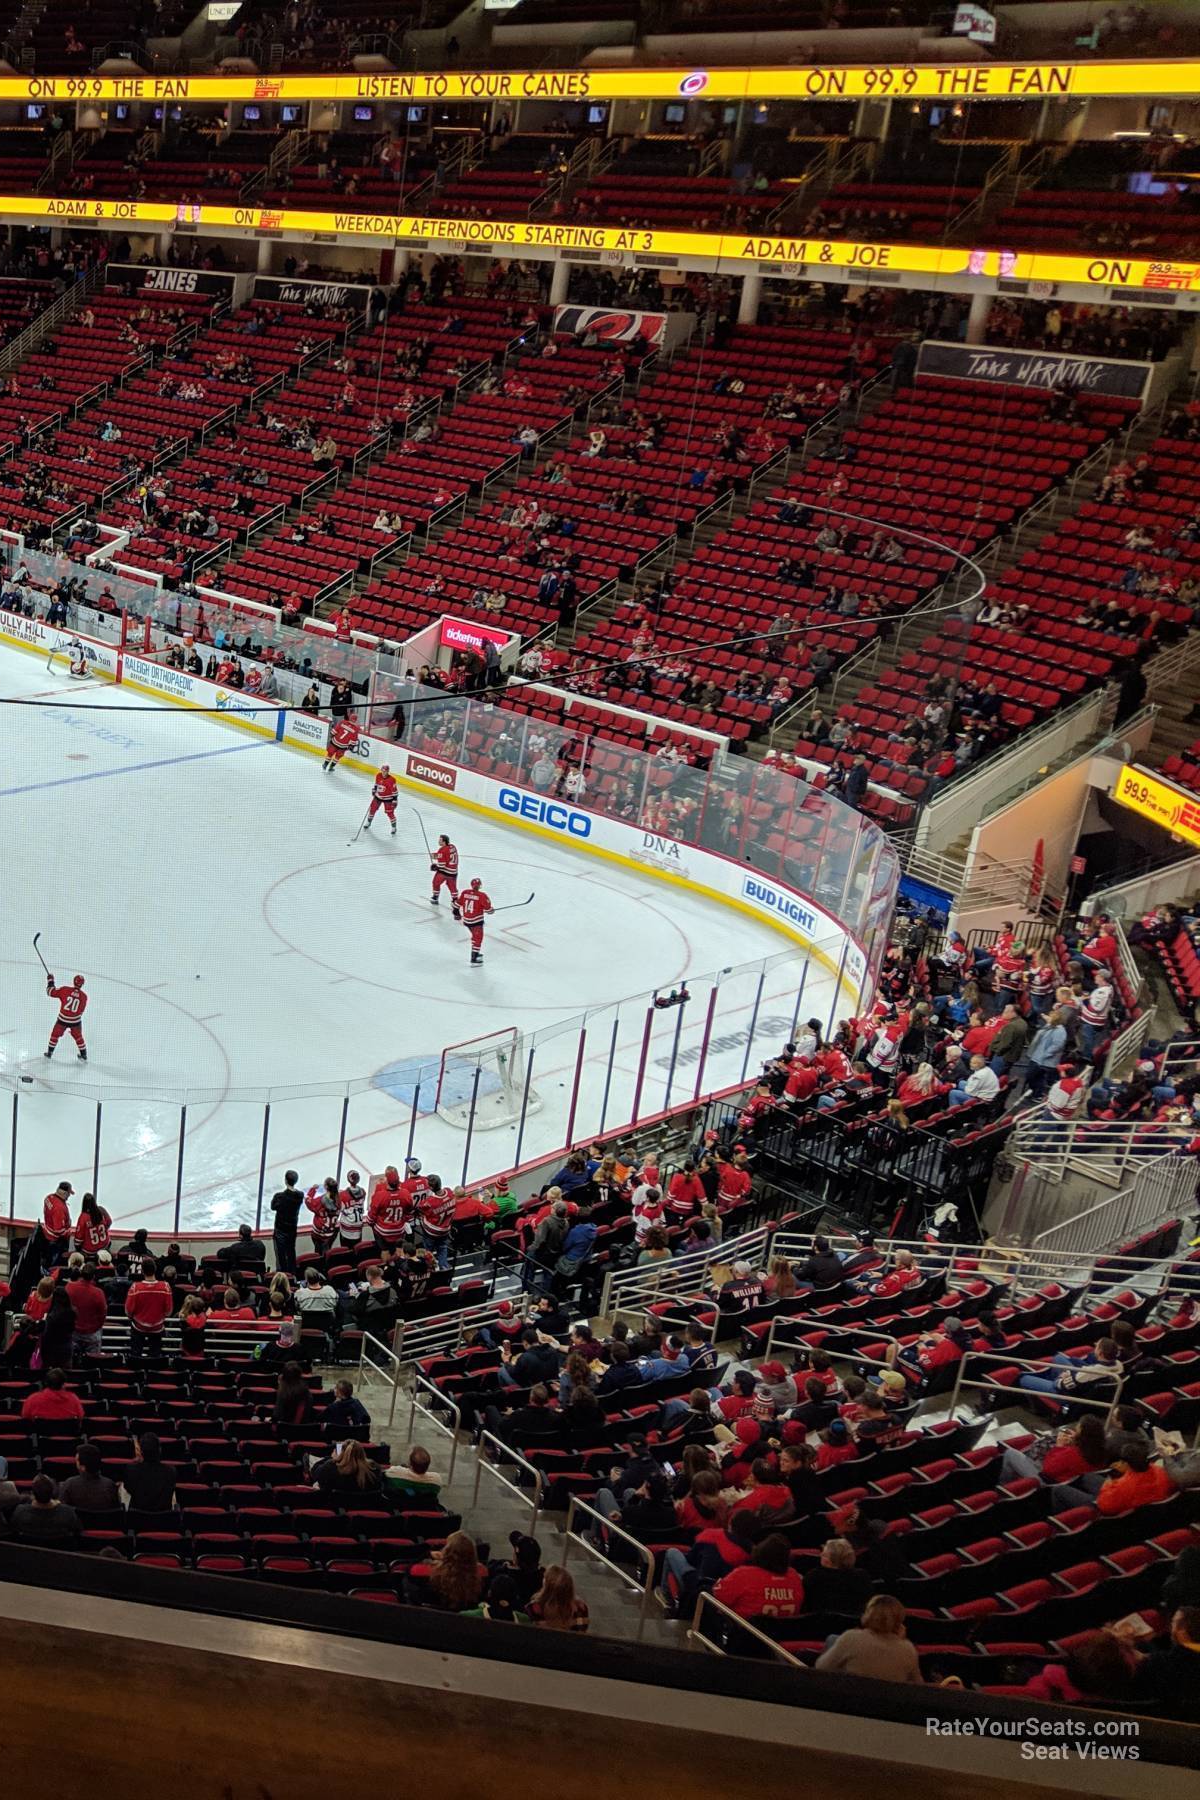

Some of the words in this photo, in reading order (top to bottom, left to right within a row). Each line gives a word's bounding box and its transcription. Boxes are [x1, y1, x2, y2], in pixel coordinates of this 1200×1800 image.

[29, 78, 56, 97] ON
[67, 78, 102, 97] 99.9
[113, 79, 144, 97] THE
[155, 79, 189, 97] FAN
[357, 76, 414, 97] LISTEN
[425, 74, 448, 97] TO
[460, 74, 511, 97] YOUR
[522, 73, 590, 96] CANES
[806, 69, 846, 95] ON
[864, 69, 918, 94] 99.9
[936, 69, 990, 93] THE
[1008, 67, 1071, 93] FAN
[46, 200, 87, 216] ADAM
[94, 203, 104, 216] &
[112, 203, 137, 218] JOE
[234, 209, 254, 224] ON
[335, 215, 402, 233] WEEKDAY
[410, 222, 516, 242] AFTERNOONS
[524, 226, 605, 247] STARTING
[615, 231, 639, 248] AT
[642, 233, 653, 250] 3
[608, 252, 620, 261] 104
[742, 239, 807, 261] ADAM
[819, 243, 833, 263] &
[846, 246, 890, 266] JOE
[784, 263, 798, 273] 105
[1087, 260, 1131, 283] ON
[1148, 264, 1171, 274] 99.9
[144, 270, 198, 293] CANES
[1143, 273, 1192, 290] ESPN
[278, 284, 301, 301] TAKE
[968, 353, 1011, 376] TAKE
[1016, 355, 1109, 389] WARNING
[2, 627, 38, 644] VINEYARDS
[24, 621, 47, 640] HILL
[98, 653, 111, 667] Sun
[124, 656, 150, 676] RALEIGH
[151, 665, 194, 691] ORTHOPAEDIC
[292, 725, 315, 738] POWERED
[293, 719, 323, 735] ANALYTICS
[340, 729, 349, 740] 7
[409, 760, 455, 785] Lenovo
[1123, 778, 1149, 804] 99.9
[498, 788, 592, 838] GEICO
[643, 832, 681, 860] DNA
[464, 899, 474, 914] 14
[745, 880, 777, 906] BUD
[777, 895, 815, 931] LIGHT
[63, 996, 80, 1013] 20
[383, 1207, 403, 1223] 20
[89, 1224, 108, 1246] 53
[410, 1280, 427, 1298] 14
[764, 1586, 795, 1602] FAULK
